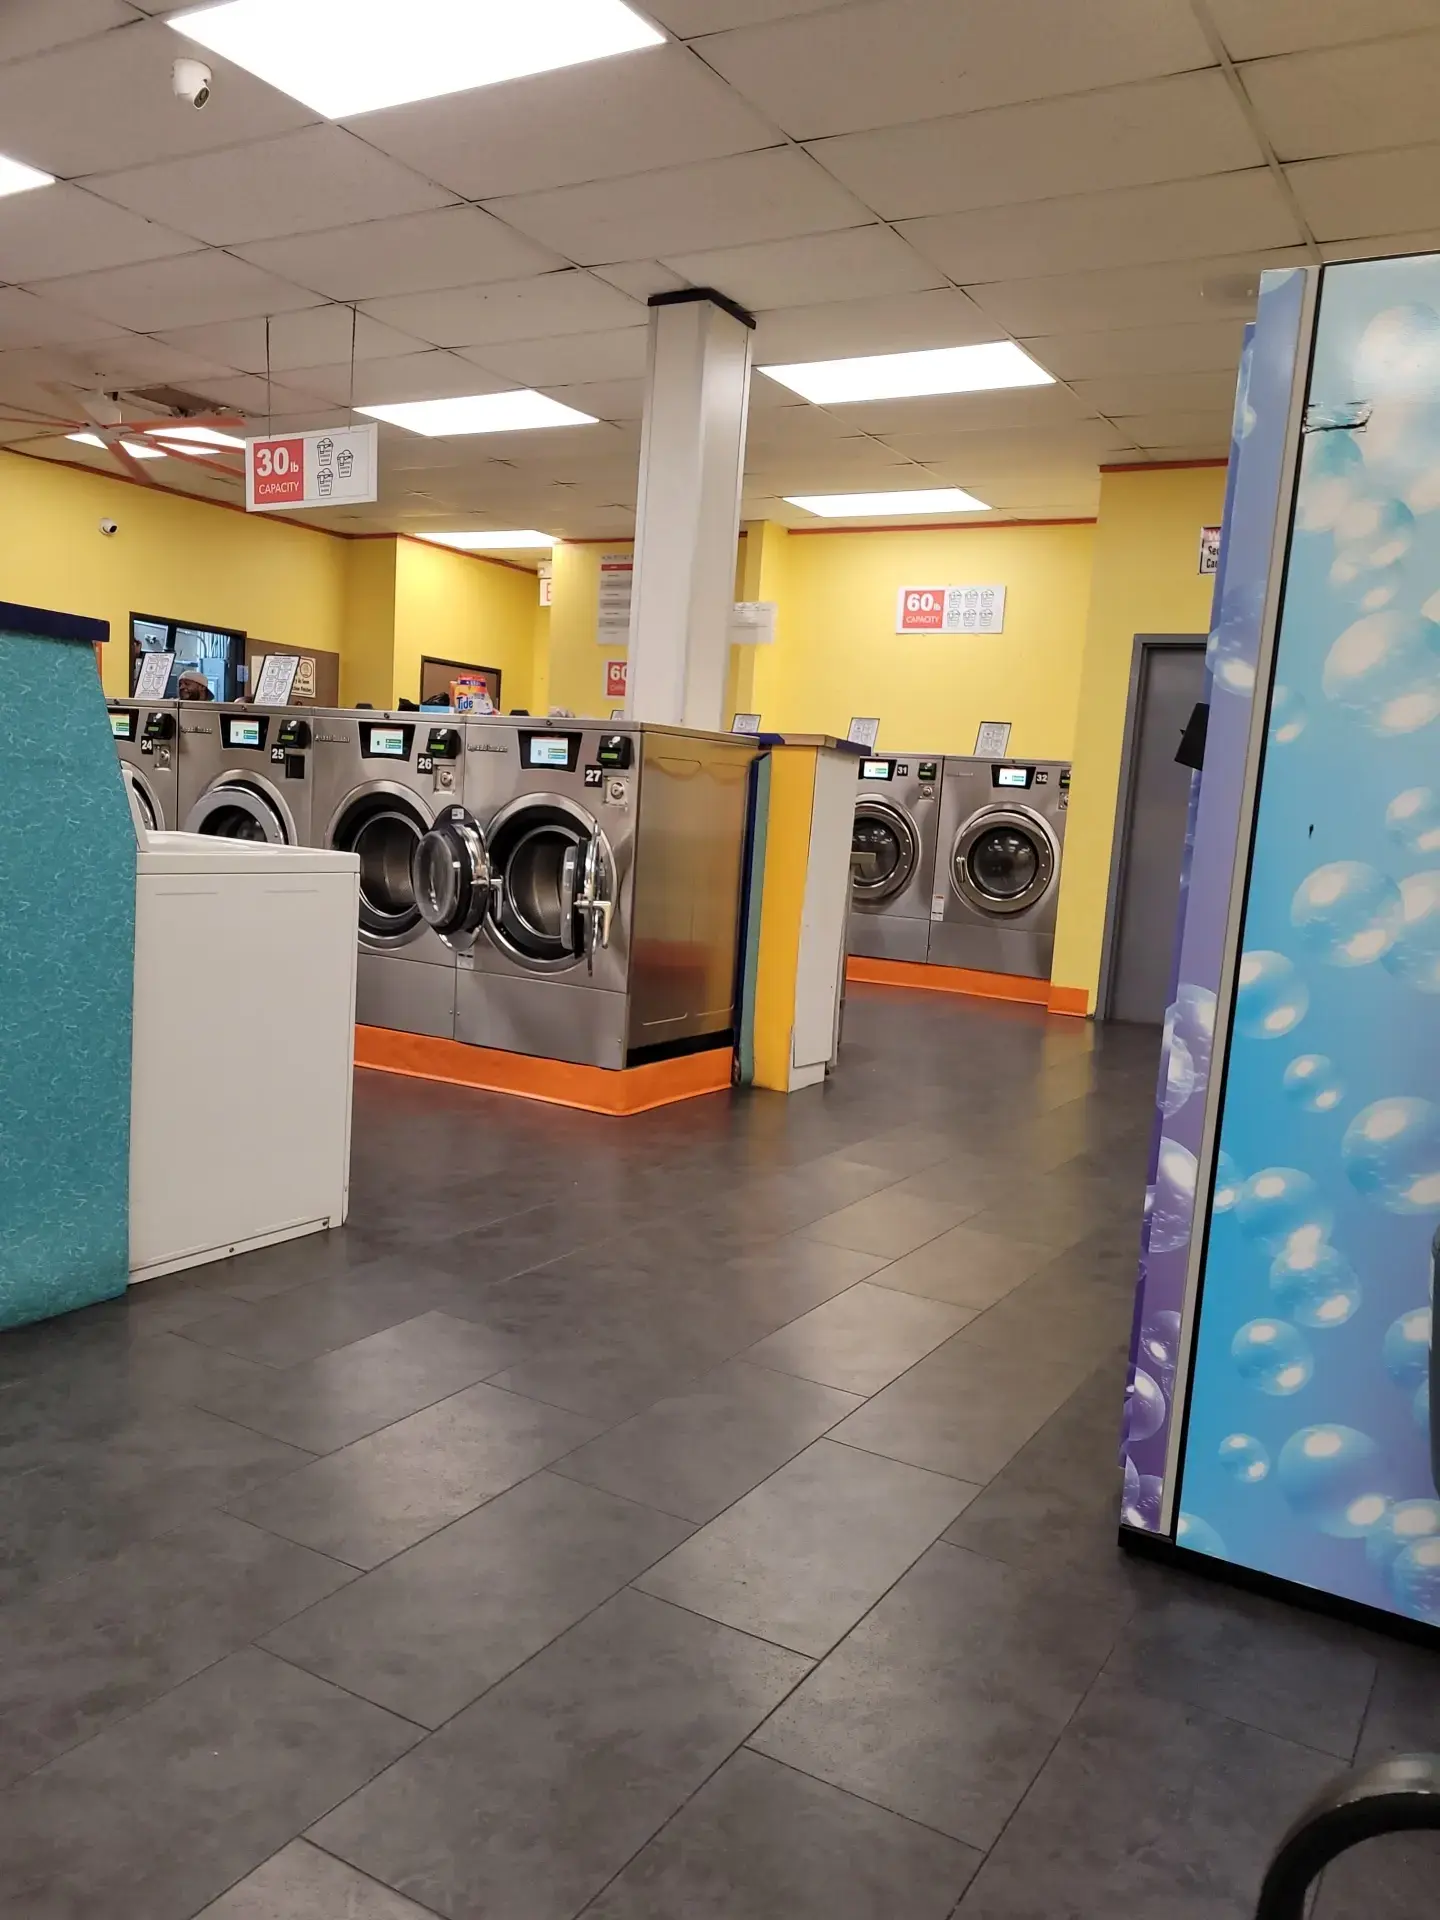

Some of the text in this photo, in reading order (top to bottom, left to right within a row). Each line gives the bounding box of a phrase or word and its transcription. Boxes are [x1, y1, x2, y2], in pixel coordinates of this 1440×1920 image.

[258, 481, 300, 494] CAPACITY
[905, 615, 940, 624] CAPACITY
[456, 696, 474, 710] Tide
[141, 739, 153, 750] 24
[271, 748, 284, 760] 25
[418, 757, 432, 770] 26
[585, 769, 602, 782] 27
[897, 766, 908, 775] 31
[1036, 774, 1048, 783] 32
